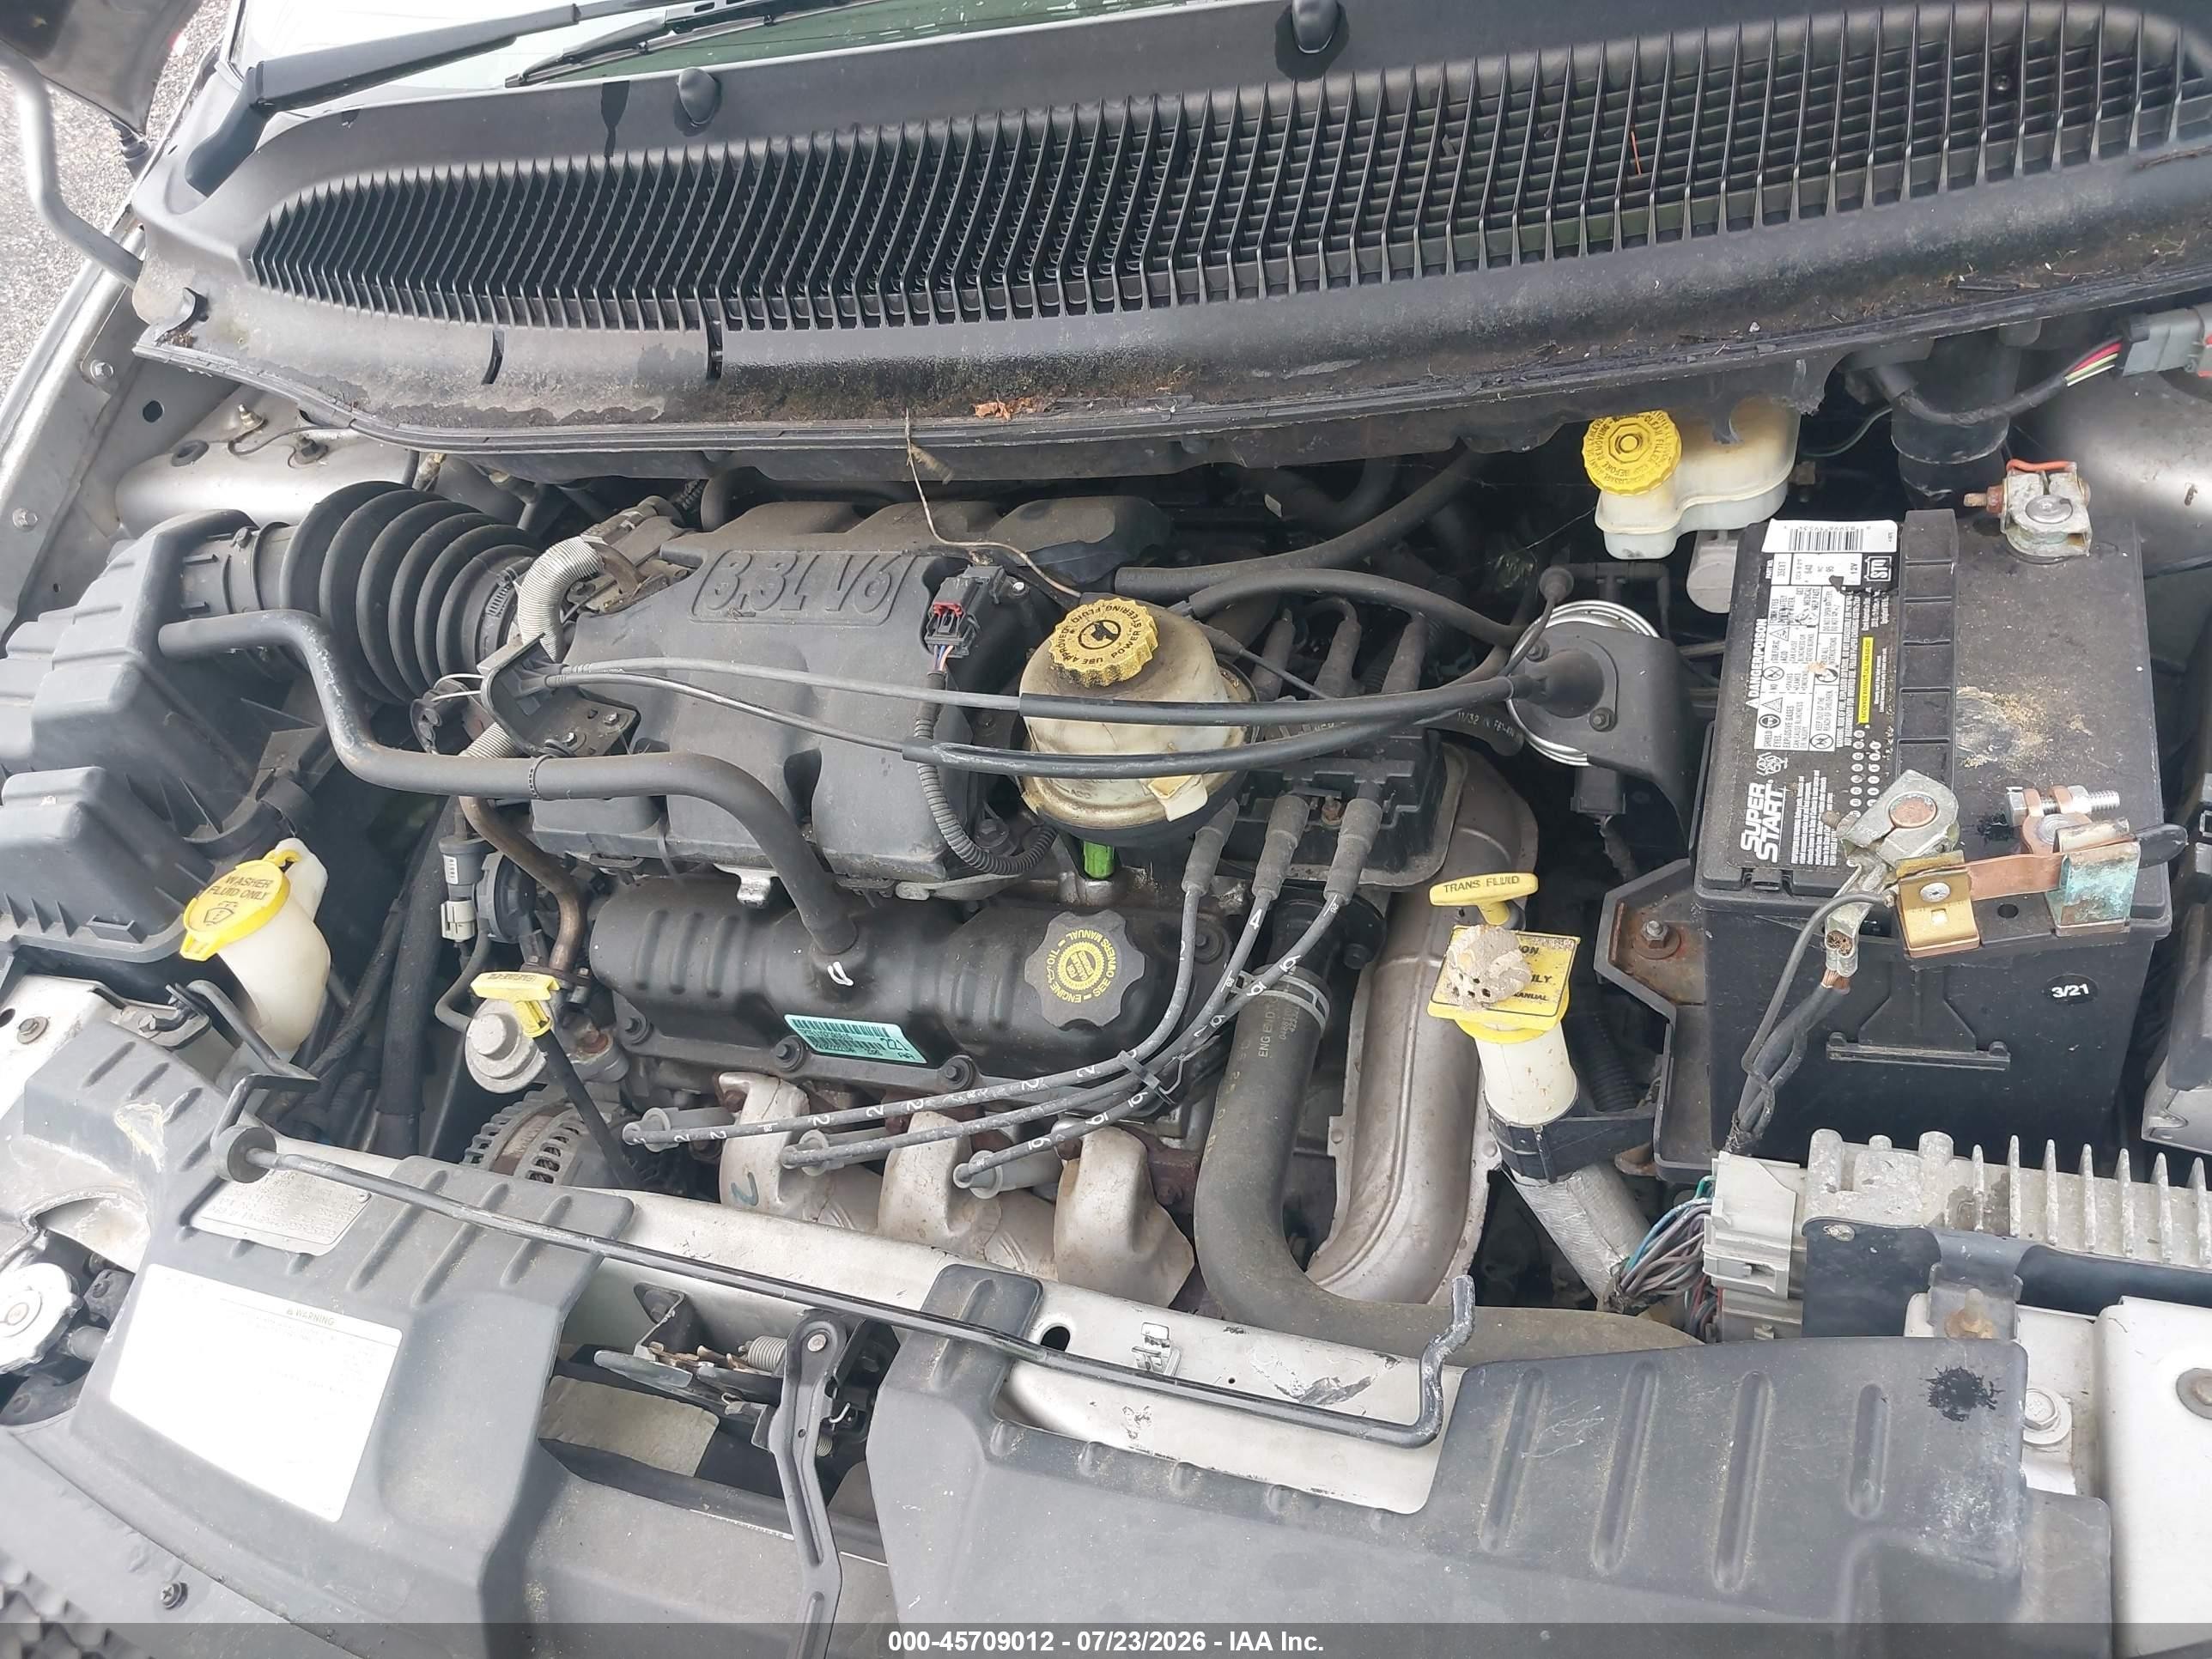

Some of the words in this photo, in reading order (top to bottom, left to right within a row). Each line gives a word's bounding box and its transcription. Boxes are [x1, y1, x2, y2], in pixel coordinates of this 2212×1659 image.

[1850, 563, 1858, 574] 12V
[703, 552, 820, 613] 3.3L
[824, 553, 902, 614] V6
[1073, 606, 1101, 624] FLUID
[1105, 605, 1142, 630] STEERING
[1056, 626, 1079, 663] APPROVED
[1110, 630, 1140, 659] POWER
[1748, 618, 1768, 697] DANGER/POISON
[1780, 650, 1789, 661] ACID
[1764, 730, 1772, 747] SHIELD
[1782, 722, 1793, 748] EXPLOSIVE
[1741, 782, 1765, 853] SUPER
[1755, 782, 1784, 863] START
[224, 875, 274, 889] WASHER
[1443, 878, 1481, 894] TRANS
[1486, 875, 1521, 887] FLUID
[209, 885, 240, 896] FLUID
[240, 890, 270, 901] ONLY
[1065, 929, 1104, 943] MANUAL
[1047, 948, 1060, 965] OIL
[1100, 938, 1116, 979] OWNERS
[1049, 981, 1082, 1003] ENGINE
[1092, 979, 1111, 998] SEE
[2051, 984, 2089, 998] 3/21
[880, 1037, 909, 1052] 221
[1258, 1036, 1272, 1058] ENG
[295, 1309, 336, 1327] WARNING
